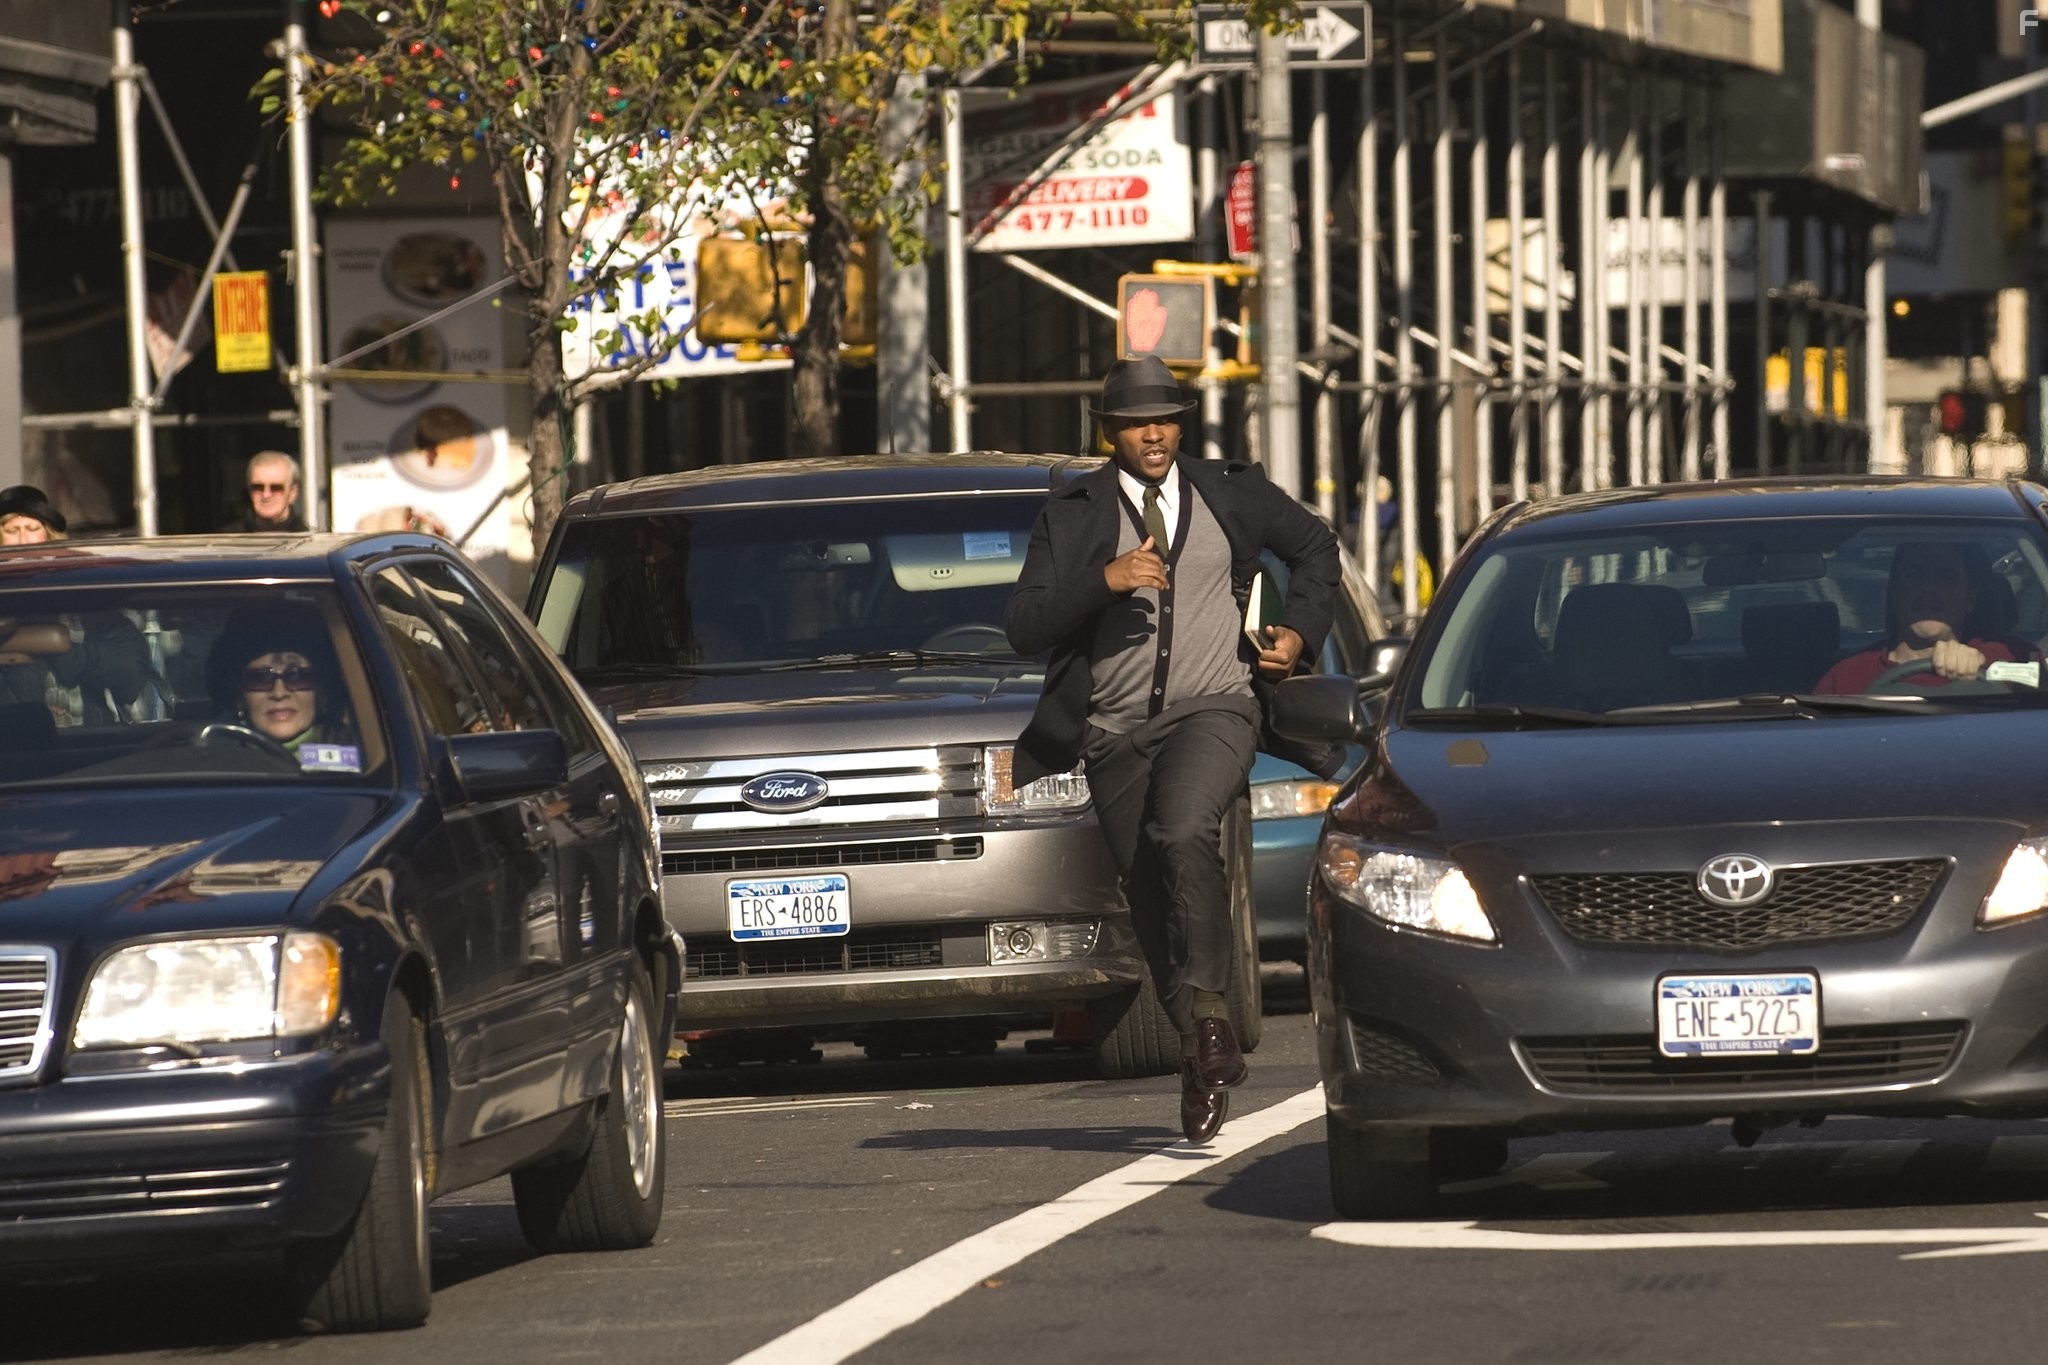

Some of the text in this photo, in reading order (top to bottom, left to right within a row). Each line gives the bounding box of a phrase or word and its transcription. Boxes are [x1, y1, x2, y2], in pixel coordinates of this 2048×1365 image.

[1086, 149, 1162, 169] SODA
[1025, 178, 1132, 203] ELIVERY
[760, 779, 808, 798] Ford
[759, 880, 818, 896] NEW YORK
[760, 926, 821, 937] THE EMPIRE STATE
[1698, 980, 1777, 997] NEW YORK
[1700, 1039, 1779, 1051] THE EMPIRE STATE
